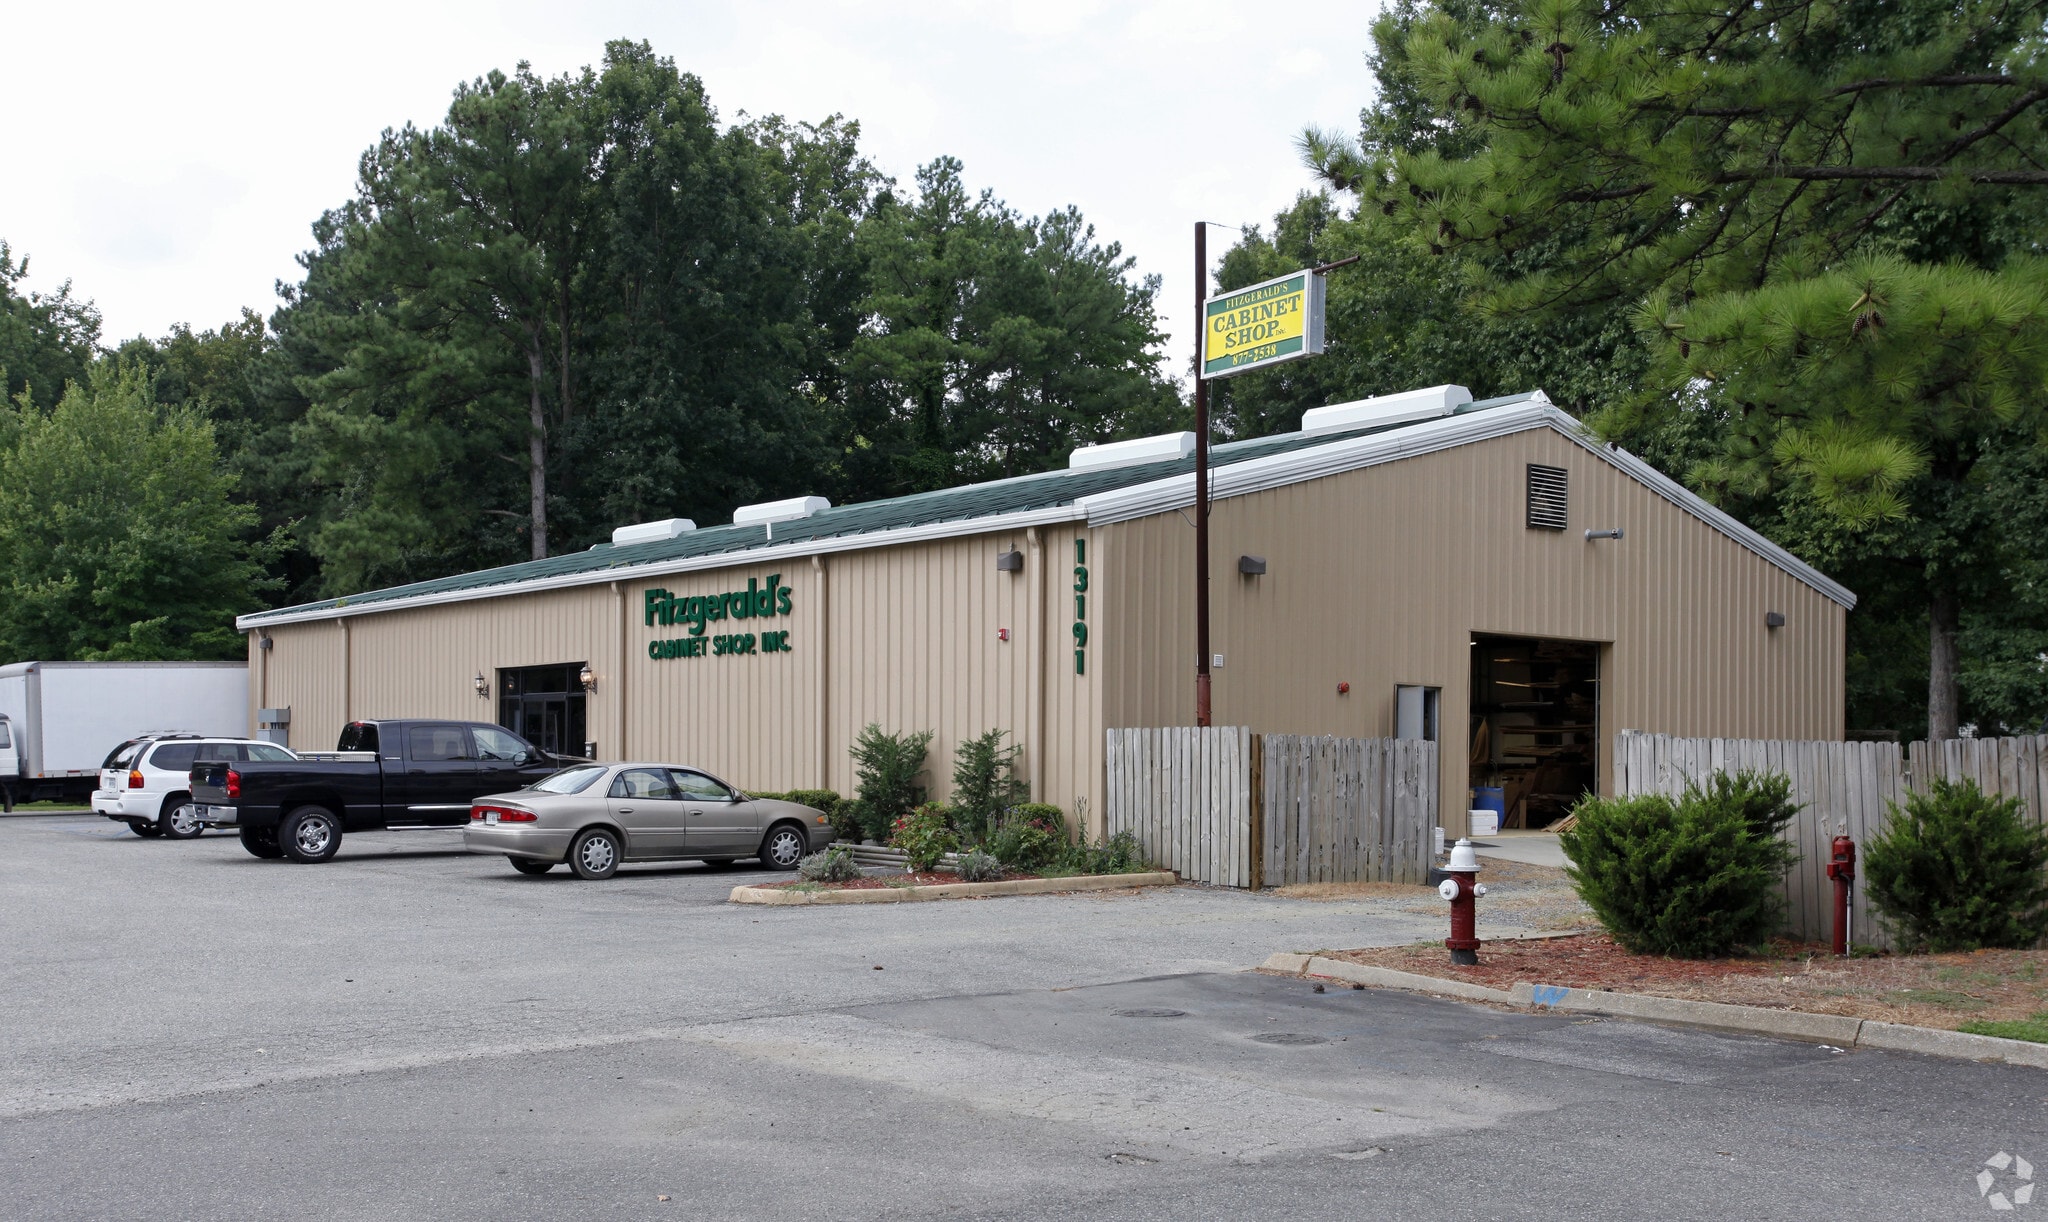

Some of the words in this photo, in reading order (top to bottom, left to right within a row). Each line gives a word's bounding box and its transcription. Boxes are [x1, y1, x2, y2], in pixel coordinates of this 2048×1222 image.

[1226, 283, 1288, 309] FITZGERALD'S
[1213, 294, 1301, 333] CABINET
[1225, 320, 1279, 349] SHOP
[1232, 344, 1277, 366] 877-2538
[645, 573, 793, 636] Fitzgerald's
[1072, 538, 1088, 675] 13191
[649, 636, 709, 660] CABINET
[761, 630, 792, 653] INC.
